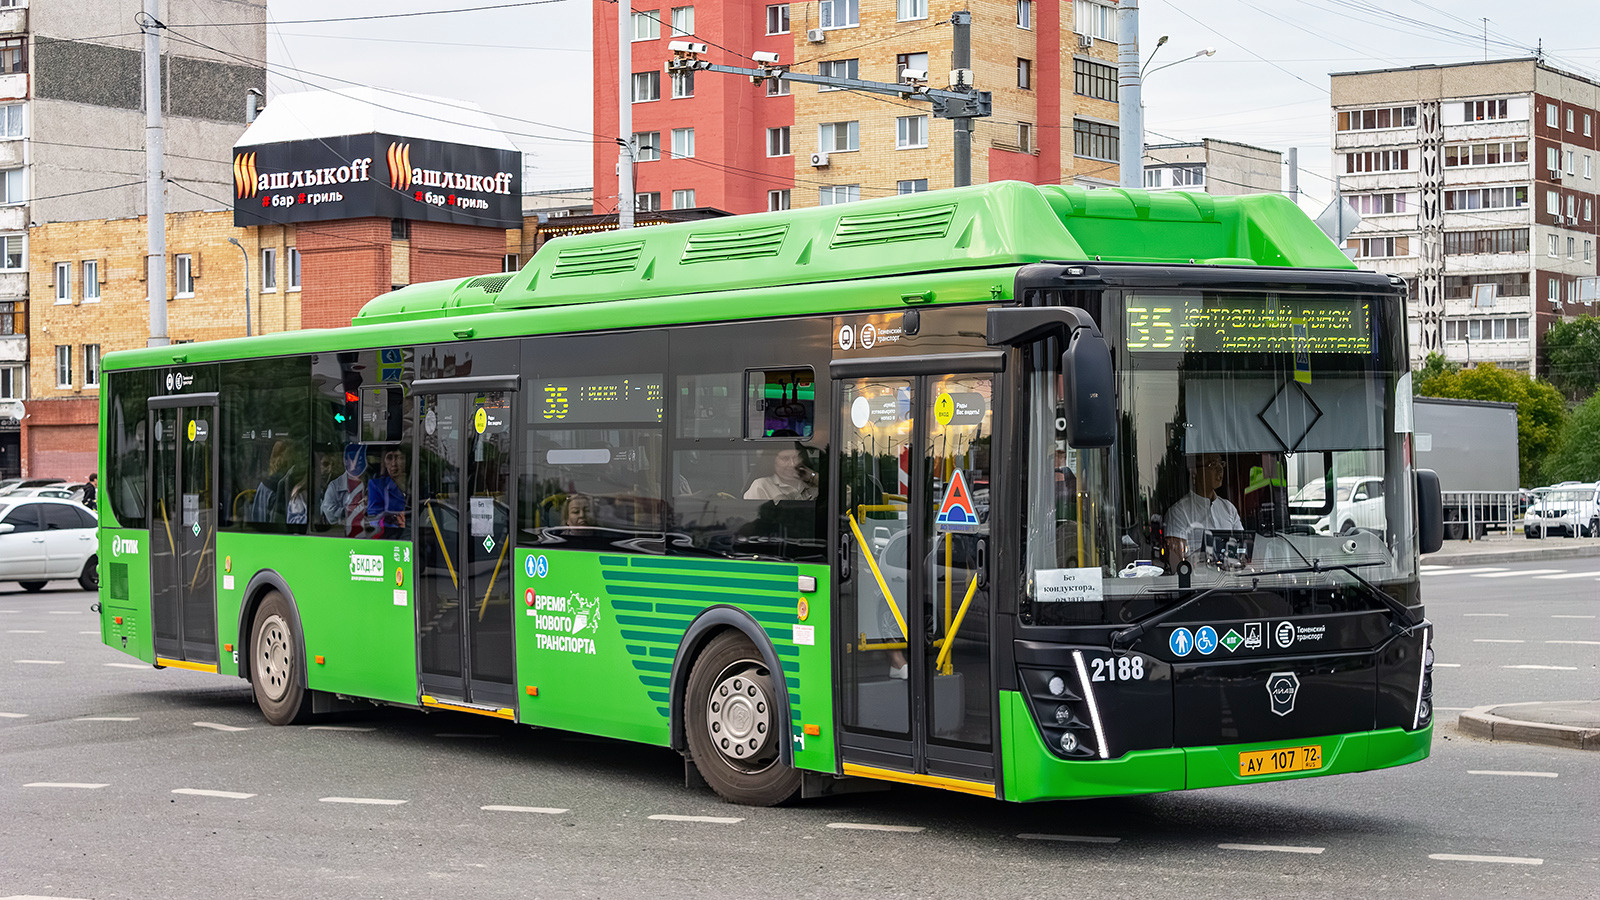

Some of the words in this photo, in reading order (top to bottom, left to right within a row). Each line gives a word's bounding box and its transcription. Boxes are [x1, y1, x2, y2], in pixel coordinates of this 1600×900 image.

[262, 194, 295, 208] #бар
[297, 190, 344, 206] #гриль
[415, 190, 446, 207] #бар
[447, 194, 489, 210] #гриль
[1362, 303, 1370, 329] 1
[1126, 307, 1175, 349] 35
[543, 383, 568, 419] 35
[356, 557, 383, 573] БКД.РФ
[1063, 573, 1076, 582] Без
[535, 594, 567, 612] ВРЕМЯ
[535, 614, 572, 633] НОВОГО
[1297, 625, 1326, 634] Тюменский
[535, 633, 597, 656] ТРАНСПОРТА
[1296, 632, 1324, 641] транспорт
[1091, 657, 1145, 682] 2188
[1247, 757, 1264, 773] АУ
[1271, 750, 1296, 770] 107
[1303, 748, 1318, 762] 72
